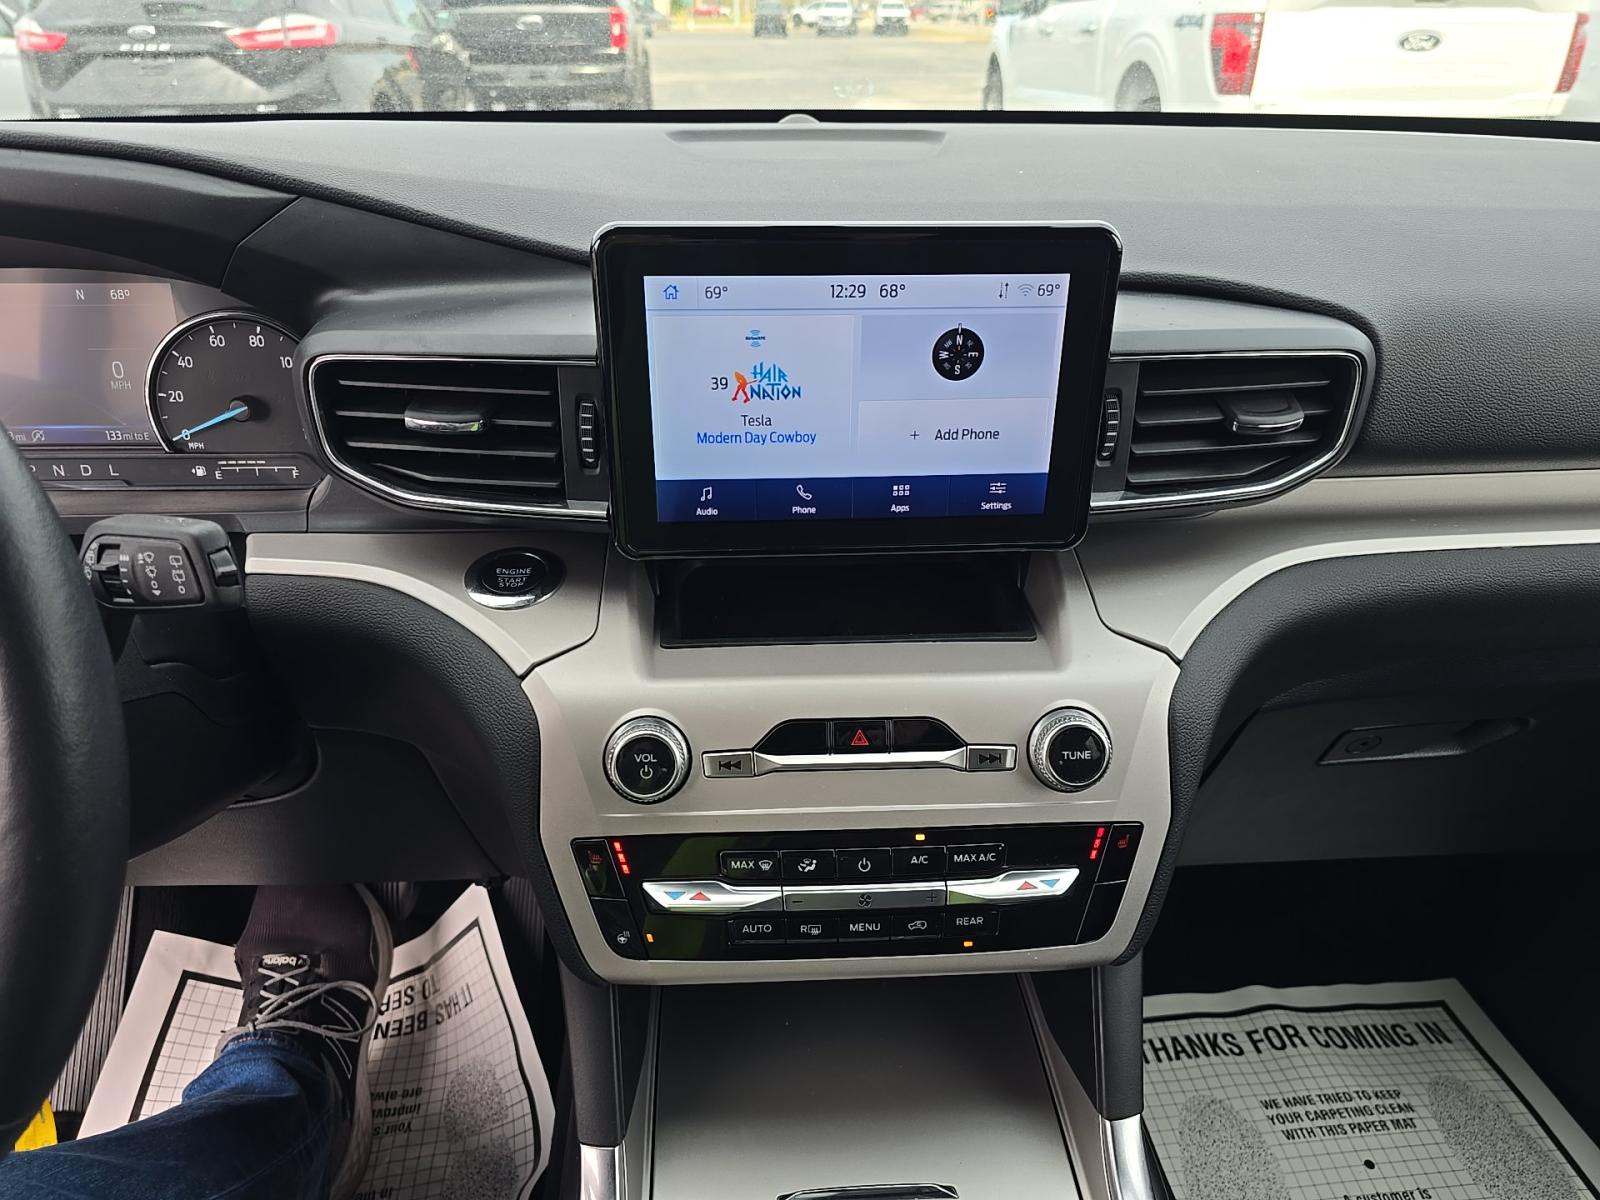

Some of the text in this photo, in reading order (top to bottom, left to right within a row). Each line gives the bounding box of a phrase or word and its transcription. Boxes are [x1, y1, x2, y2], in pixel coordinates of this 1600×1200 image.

[75, 289, 85, 300] N
[705, 286, 728, 300] 69°
[830, 284, 906, 299] 12:29 68°
[1037, 283, 1061, 297] 69°
[209, 336, 226, 347] 60
[249, 336, 265, 347] 80
[177, 356, 193, 368] 40
[279, 356, 293, 369] 10
[751, 361, 789, 383] HAIR
[110, 380, 132, 390] MPH
[711, 377, 728, 391] 39
[168, 391, 184, 402] 20
[750, 383, 802, 401] NATION
[741, 414, 772, 427] Tesla
[105, 430, 122, 441] 133
[123, 431, 133, 440] mi
[134, 432, 144, 440] to
[697, 431, 817, 446] Modern Day Cowboy
[934, 428, 1000, 441] Add Phone
[188, 442, 205, 450] MPH
[52, 464, 120, 477] N D L
[215, 470, 223, 480] E
[292, 469, 300, 479] F
[696, 507, 718, 516] Audio
[792, 506, 817, 515] Phone
[890, 504, 910, 513] Apps
[981, 502, 1012, 511] Settings
[496, 567, 532, 575] ENGINE
[634, 753, 658, 763] VOL
[1062, 750, 1092, 760] TUNE
[910, 855, 929, 864] A/C
[953, 852, 997, 863] MAX A/C
[731, 860, 755, 869] MAX
[956, 916, 984, 926] REAR
[742, 924, 772, 933] AUTO
[849, 922, 881, 932] MENU
[373, 1009, 429, 1041] BEEN
[1143, 1020, 1453, 1065] THANKS FOR COMING IN
[1261, 1089, 1402, 1111] WE HAVE TRIED TO KEEP
[372, 1103, 421, 1119] improv
[1266, 1102, 1416, 1126] YOUR CARPETING CLEAN
[1281, 1117, 1418, 1141] WITH THIS PAPER MAT
[1416, 1187, 1432, 1200] is
